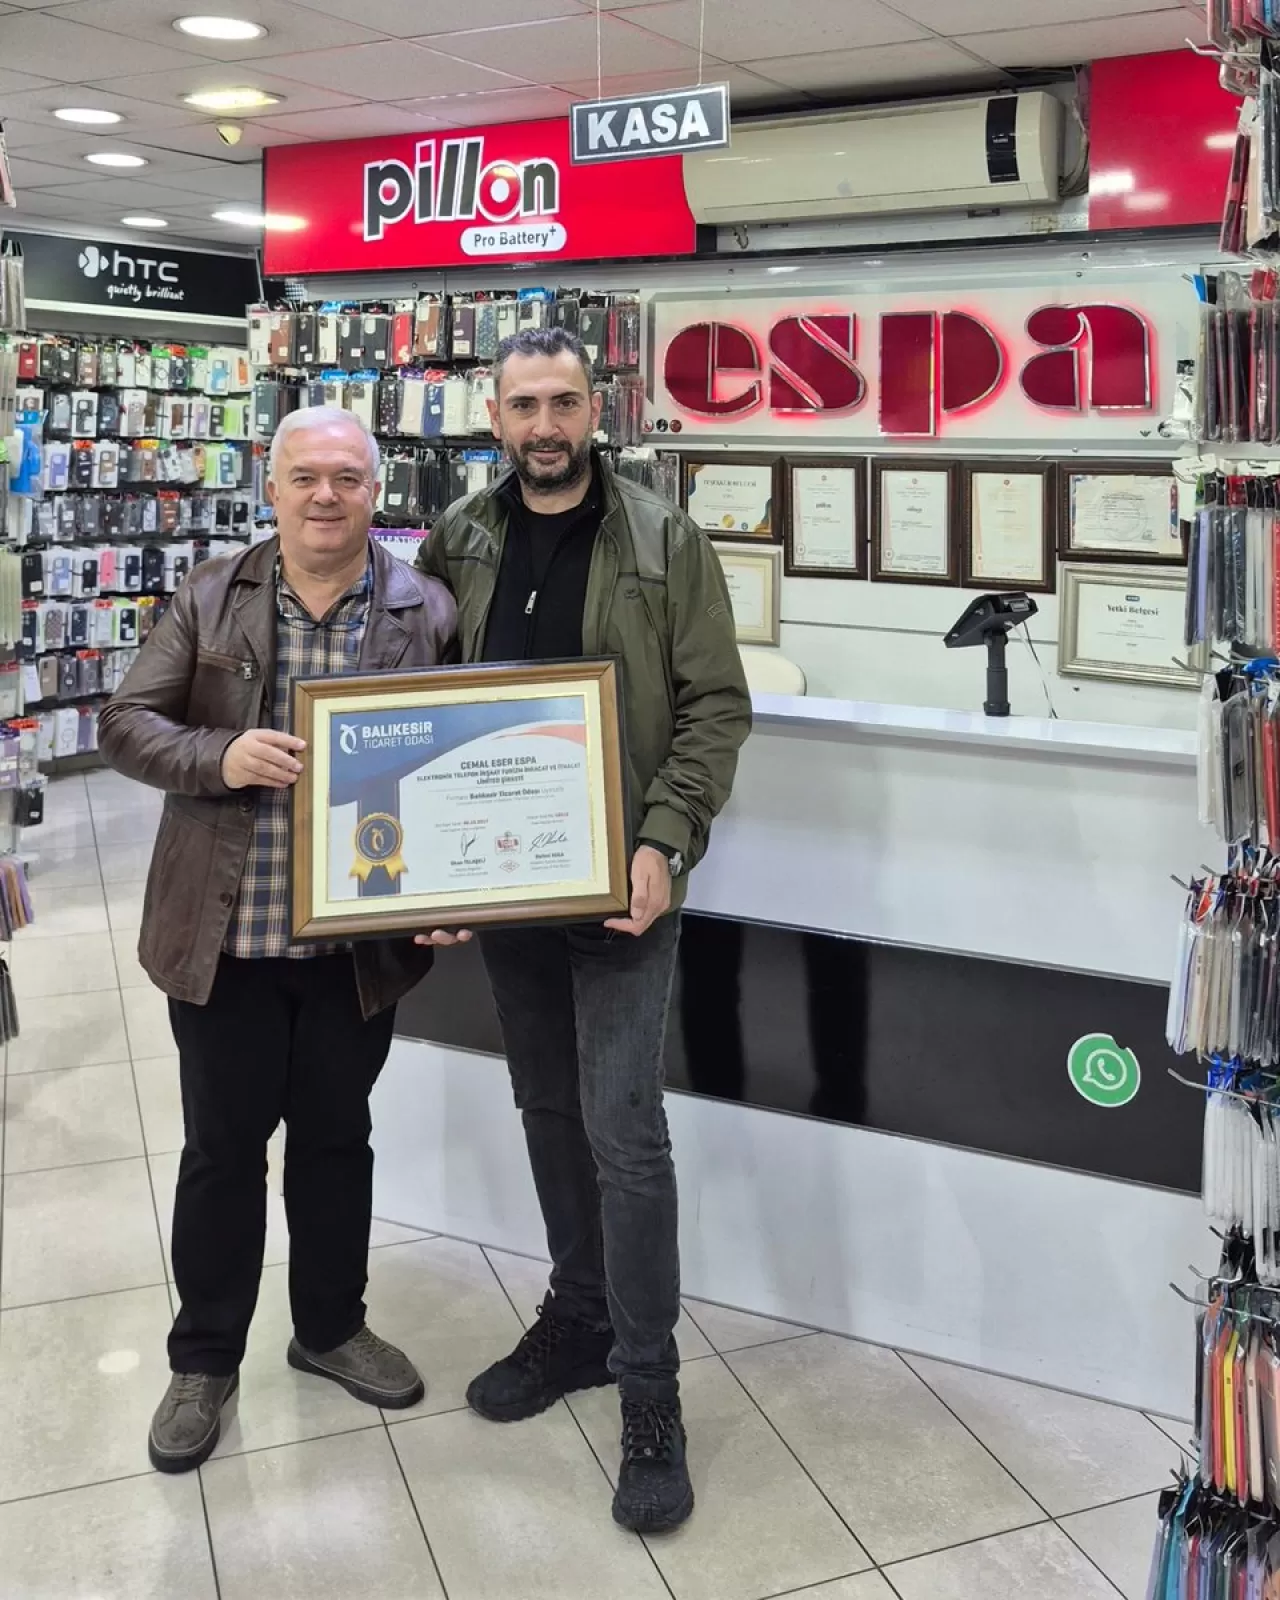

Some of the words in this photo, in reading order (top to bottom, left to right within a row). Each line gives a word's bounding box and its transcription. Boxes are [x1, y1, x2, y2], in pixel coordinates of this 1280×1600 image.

[588, 100, 710, 149] KASA
[364, 136, 560, 242] pillon
[474, 233, 496, 247] Pro
[107, 283, 142, 302] quietly
[145, 284, 185, 300] brilliant
[664, 303, 1152, 436] espa
[461, 759, 489, 771] CEMAL
[492, 758, 513, 768] ESER
[515, 756, 536, 766] ESPA
